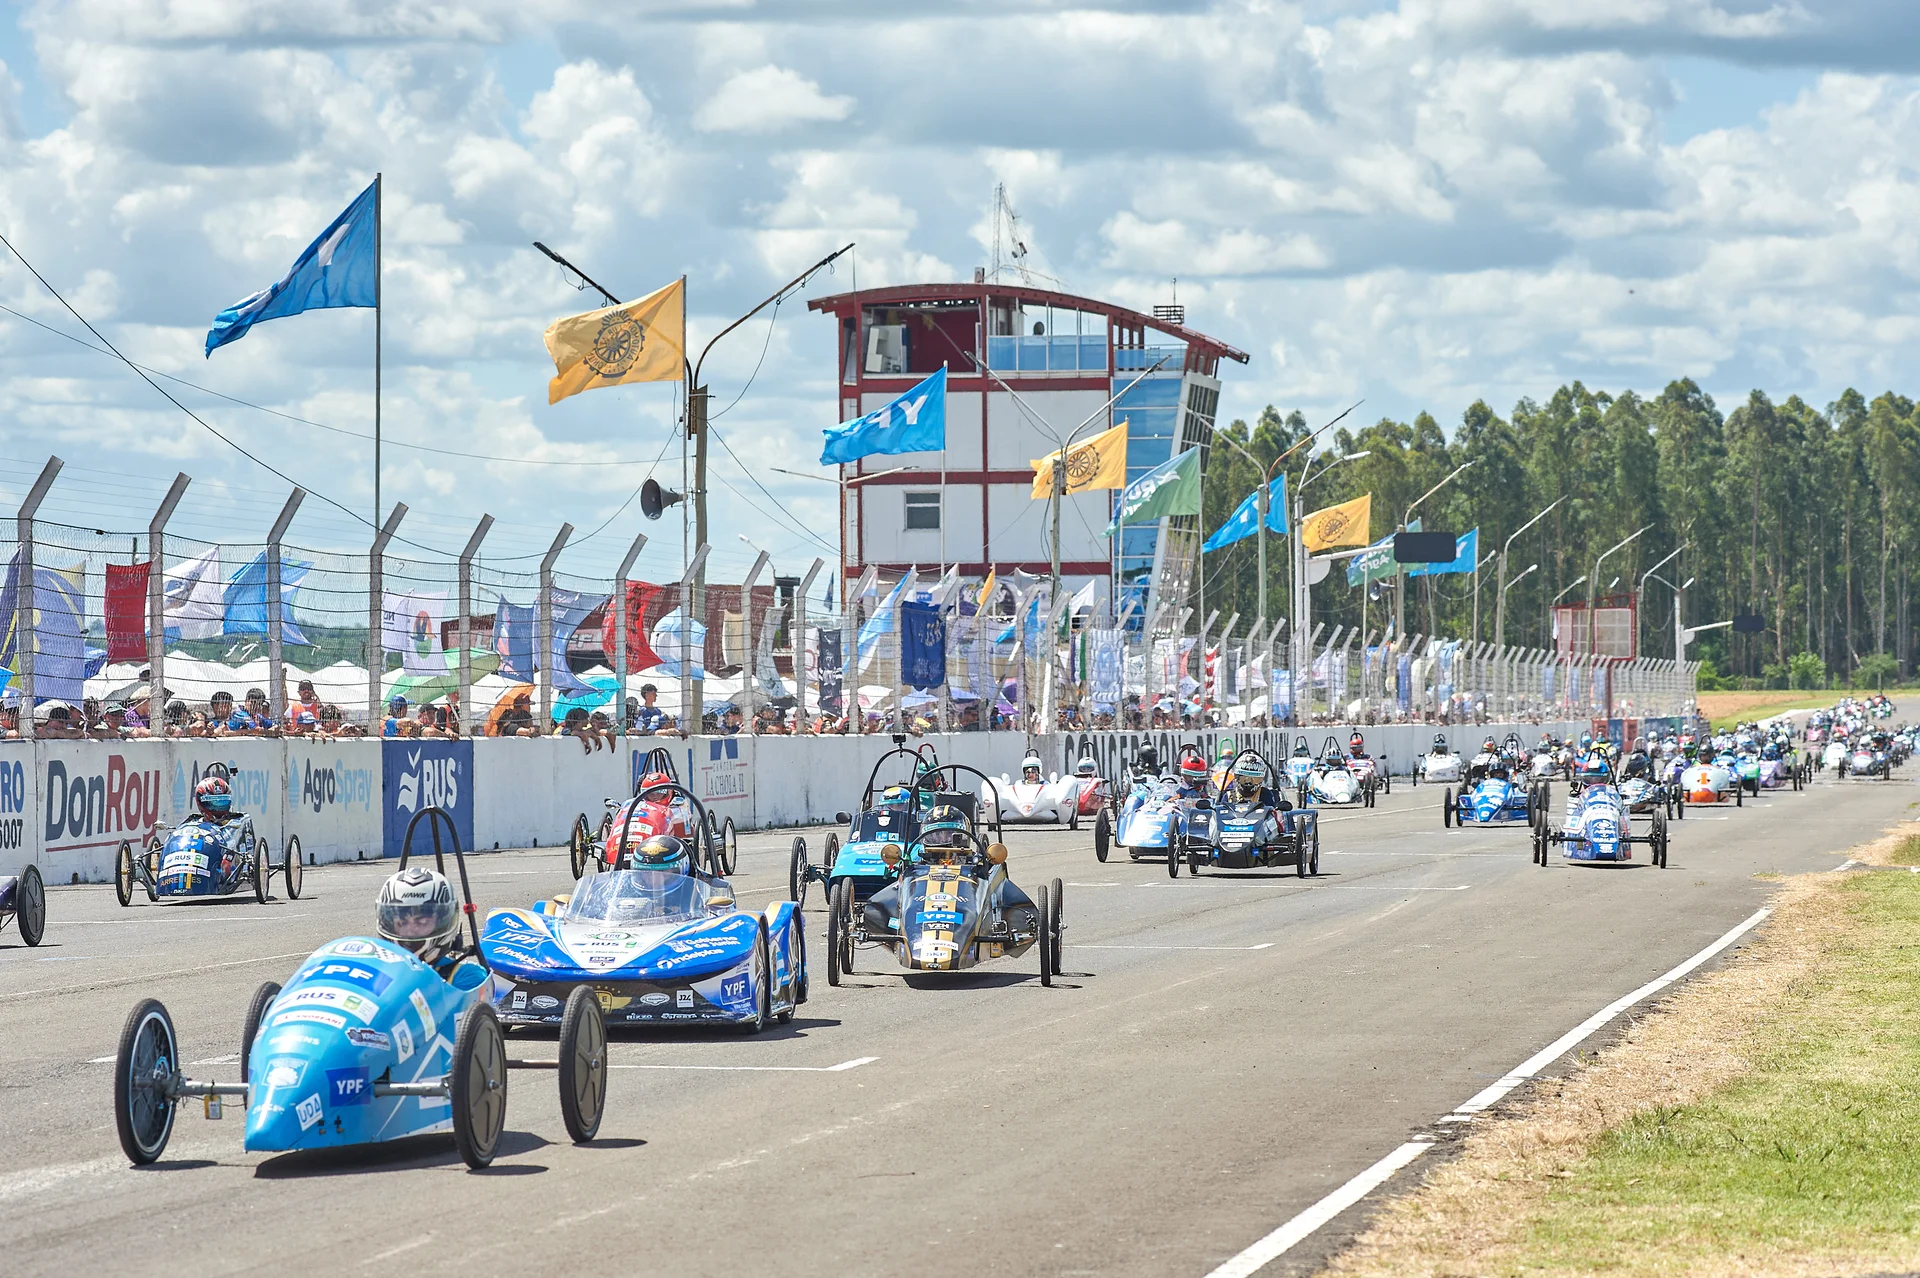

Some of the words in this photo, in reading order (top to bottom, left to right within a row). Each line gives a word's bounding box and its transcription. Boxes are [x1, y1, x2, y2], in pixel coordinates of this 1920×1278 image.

[0, 760, 24, 813] RO
[303, 757, 372, 813] AgroSpray
[422, 756, 458, 810] RUS
[45, 754, 160, 848] DonRoy
[499, 932, 544, 945] YPF
[670, 949, 725, 964] Indelplas
[301, 963, 374, 980] YPF
[296, 992, 337, 1000] RUS
[724, 980, 746, 997] YPF
[336, 1078, 364, 1095] YPF
[298, 1097, 321, 1123] UDA
